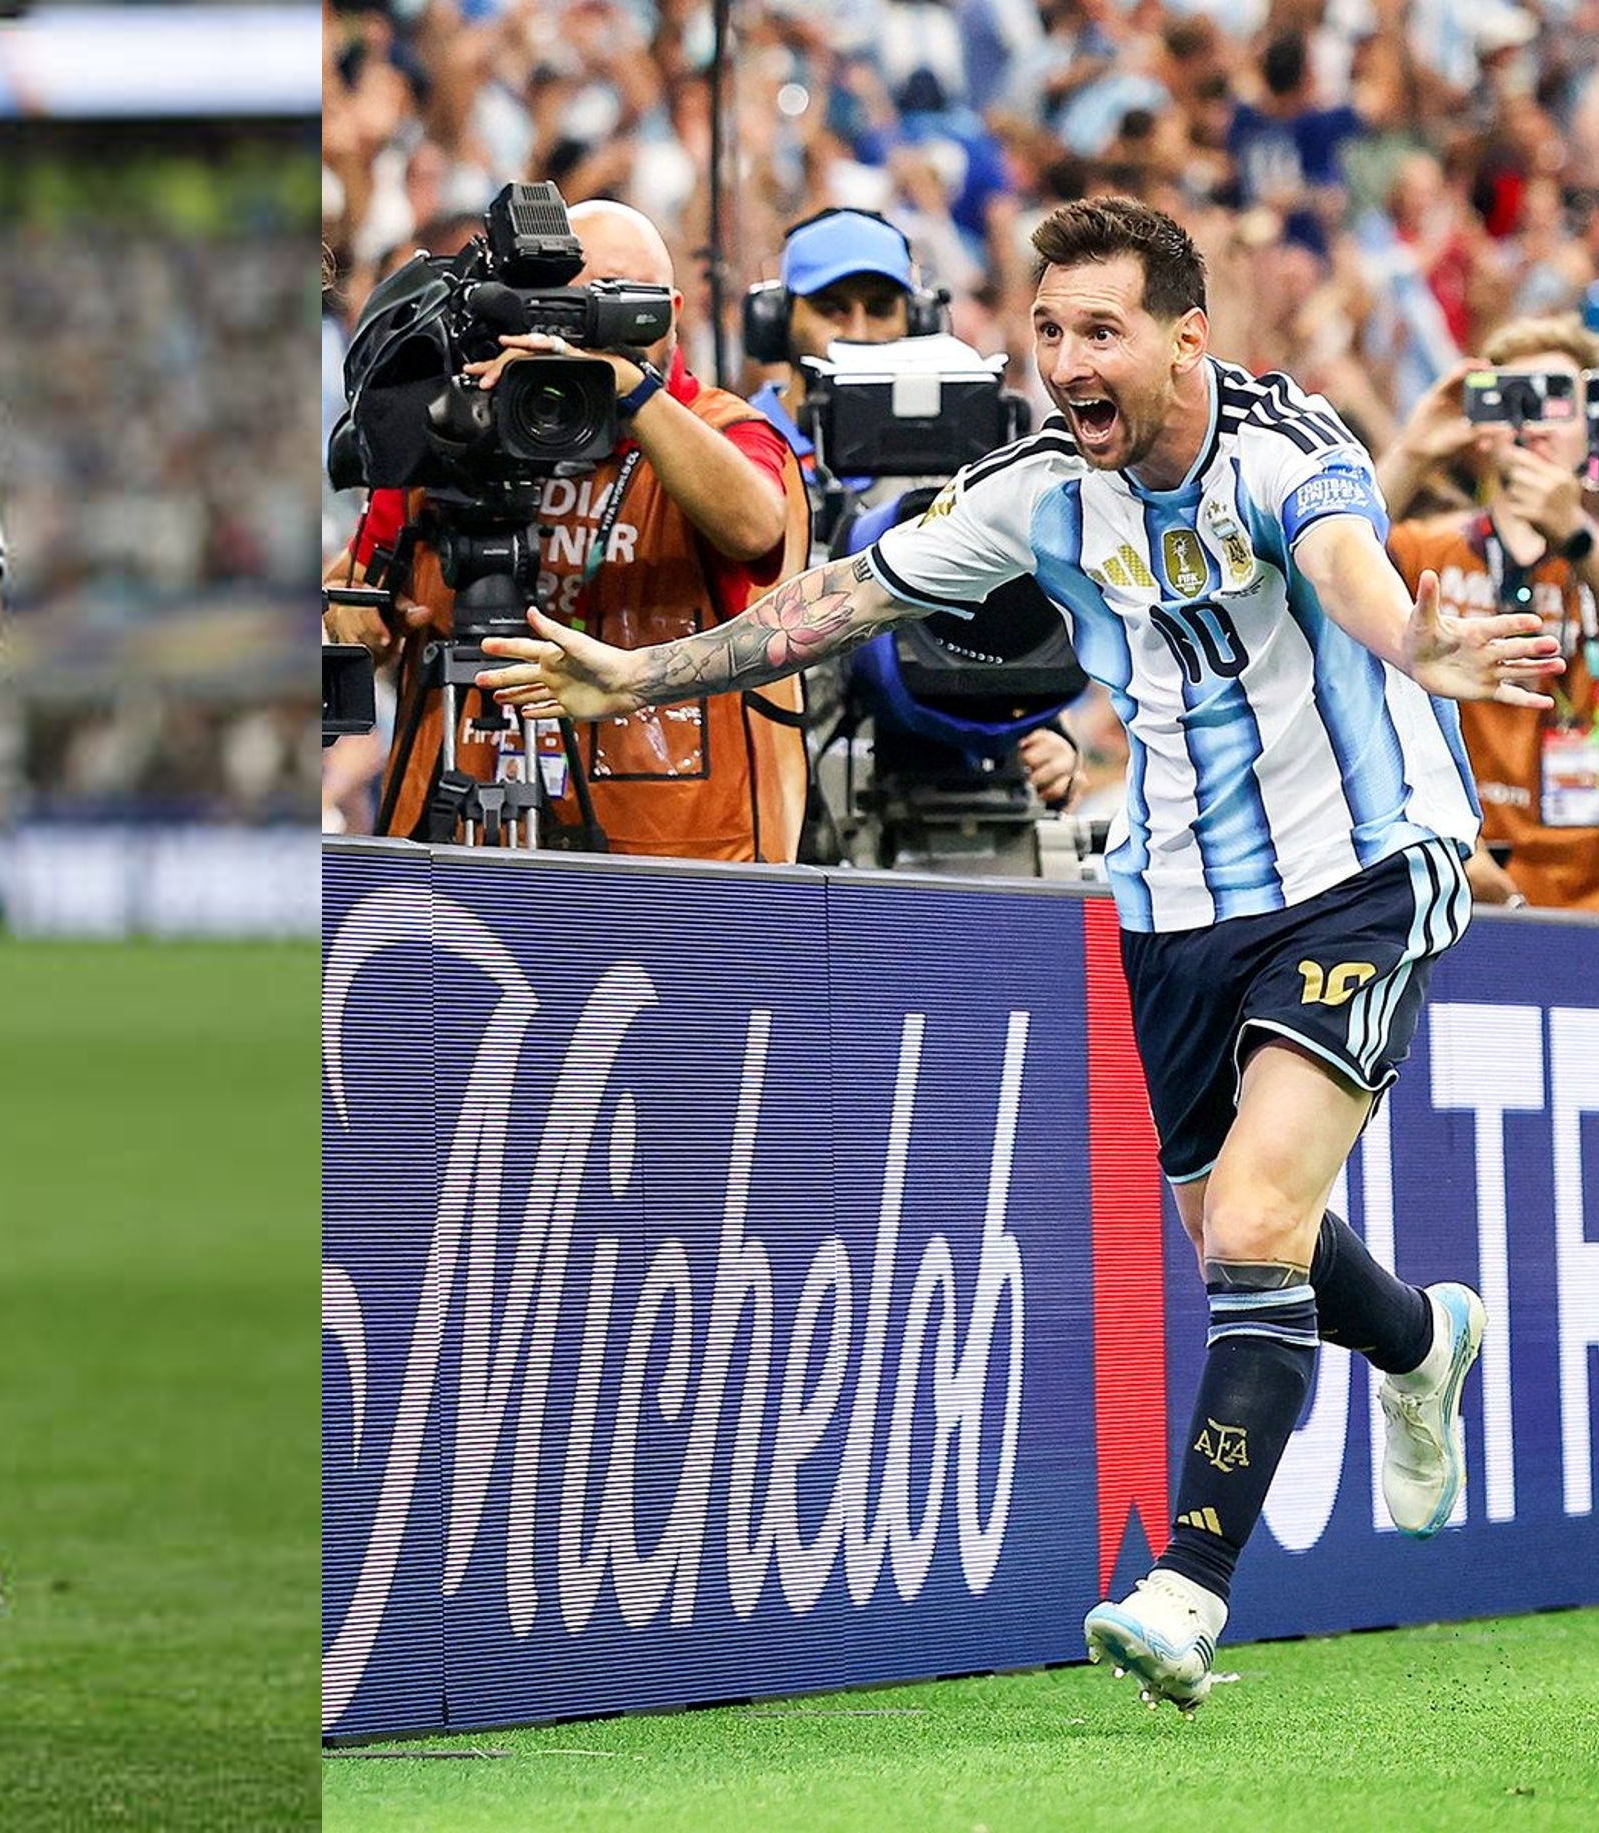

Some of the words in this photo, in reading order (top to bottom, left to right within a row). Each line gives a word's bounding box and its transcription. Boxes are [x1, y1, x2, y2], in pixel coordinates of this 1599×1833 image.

[1148, 602, 1250, 684] 10
[1298, 960, 1377, 1006] 10
[322, 883, 1031, 1732] Michelob
[1194, 1417, 1250, 1473] AFA
